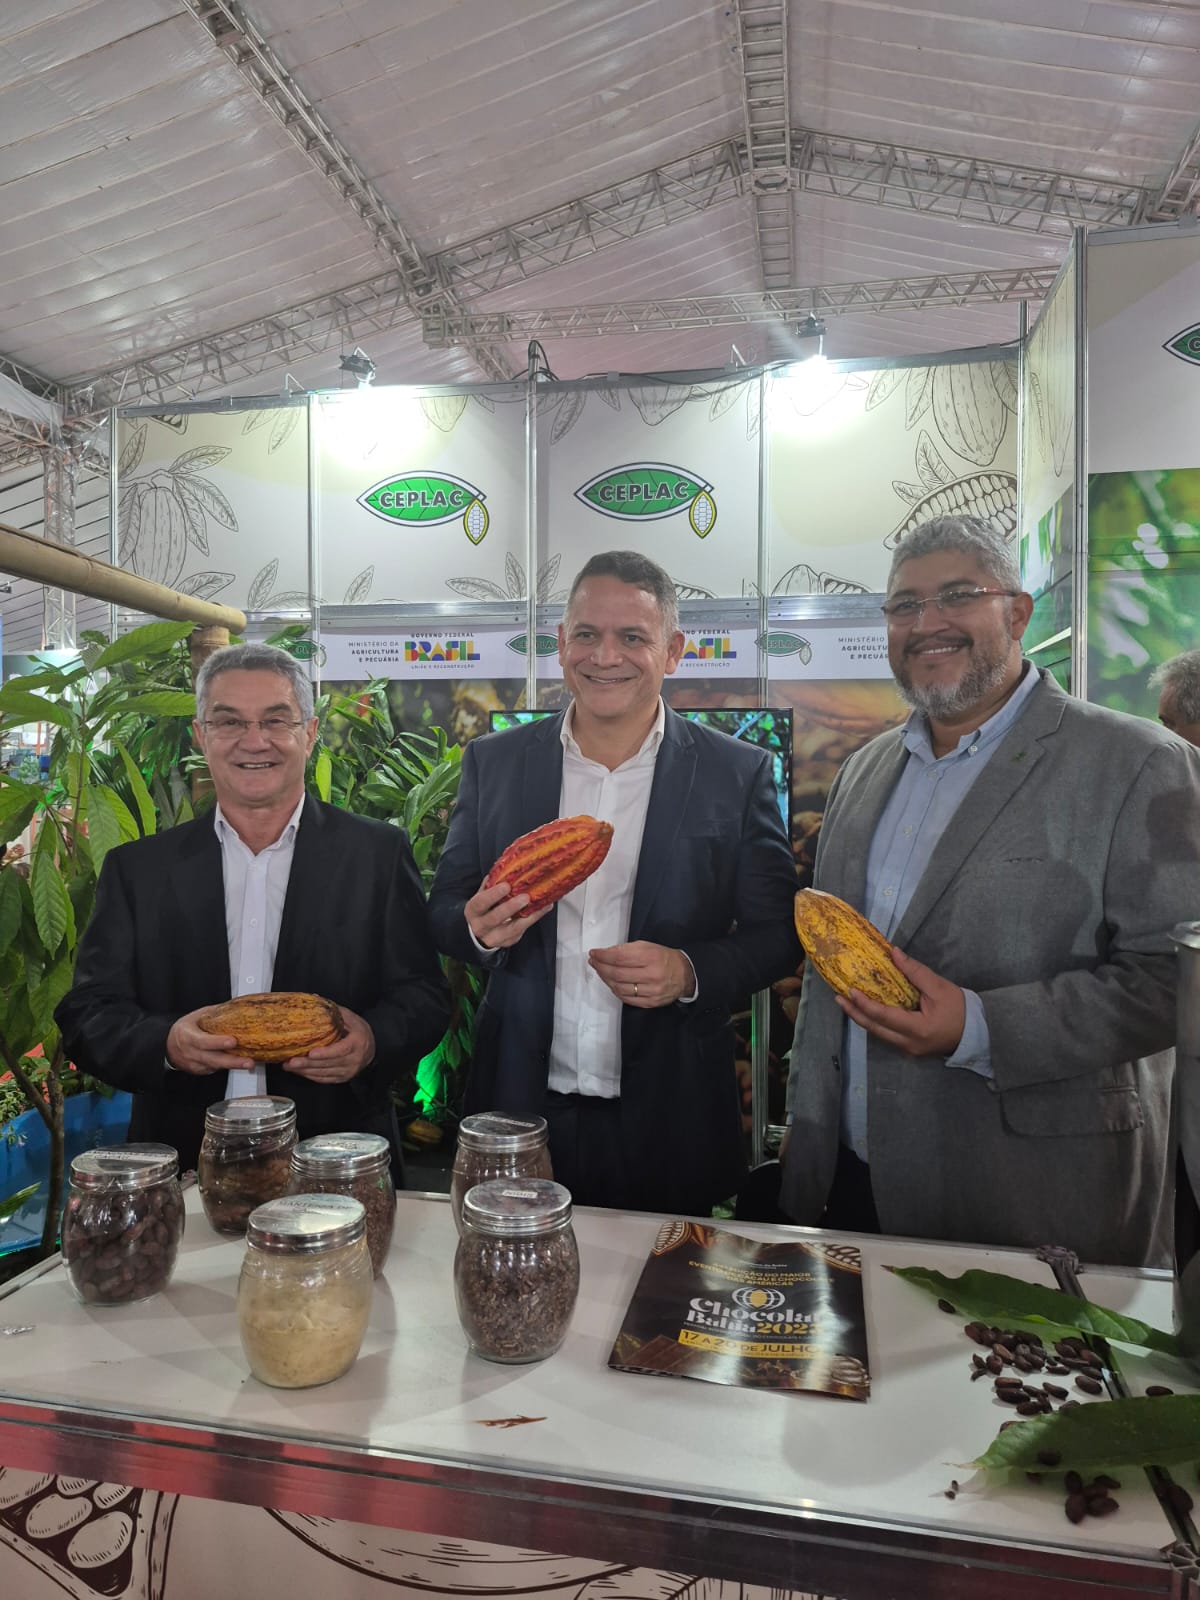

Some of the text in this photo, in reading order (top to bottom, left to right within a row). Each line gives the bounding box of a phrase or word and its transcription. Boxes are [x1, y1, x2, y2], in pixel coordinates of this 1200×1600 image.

[379, 489, 464, 509] CEPLAC
[599, 481, 690, 502] CEPLAC
[365, 655, 399, 663] PECUÁRIA
[404, 640, 481, 662] BRASIL
[680, 637, 737, 660] ASIL
[857, 652, 889, 660] PECUÁR
[683, 1330, 700, 1341] 17
[702, 1337, 711, 1345] A
[740, 1344, 758, 1352] DE
[760, 1344, 821, 1353] JULHO
